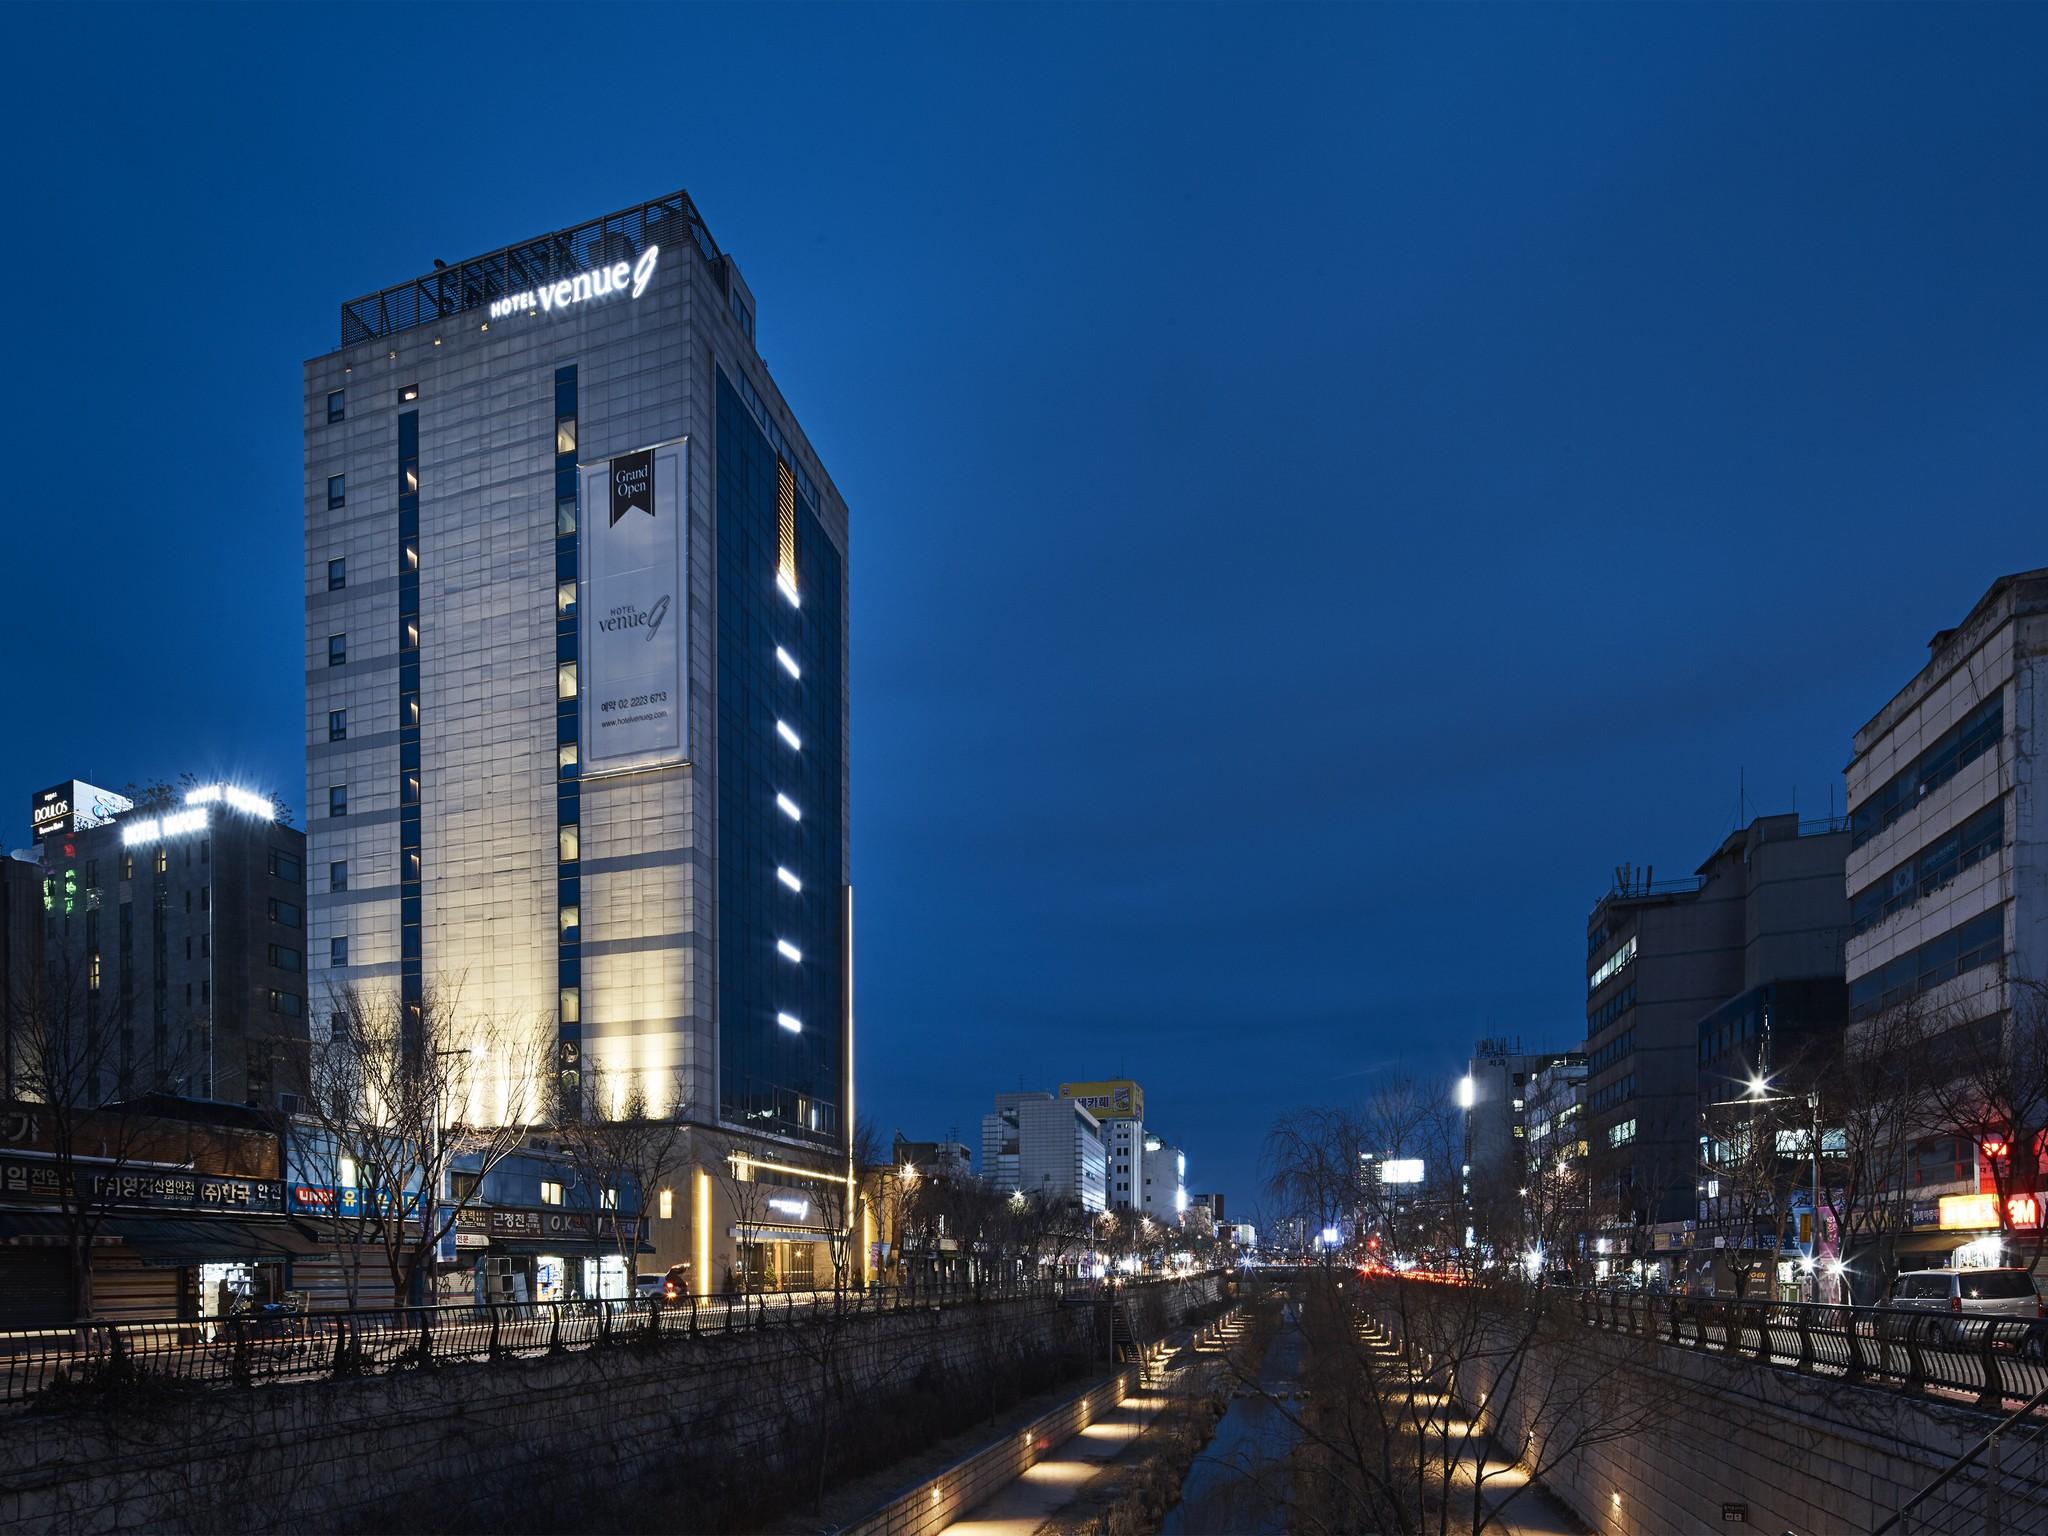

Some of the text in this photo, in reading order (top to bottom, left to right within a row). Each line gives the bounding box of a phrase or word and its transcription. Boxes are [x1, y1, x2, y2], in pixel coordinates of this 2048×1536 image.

[490, 290, 537, 319] HOTEL
[616, 464, 648, 483] Grand
[618, 481, 646, 498] Open
[610, 604, 636, 616] HOTEL
[618, 698, 629, 709] 02
[630, 695, 648, 707] 2223
[0, 1165, 28, 1191] 일
[2007, 1199, 2035, 1224] 3M
